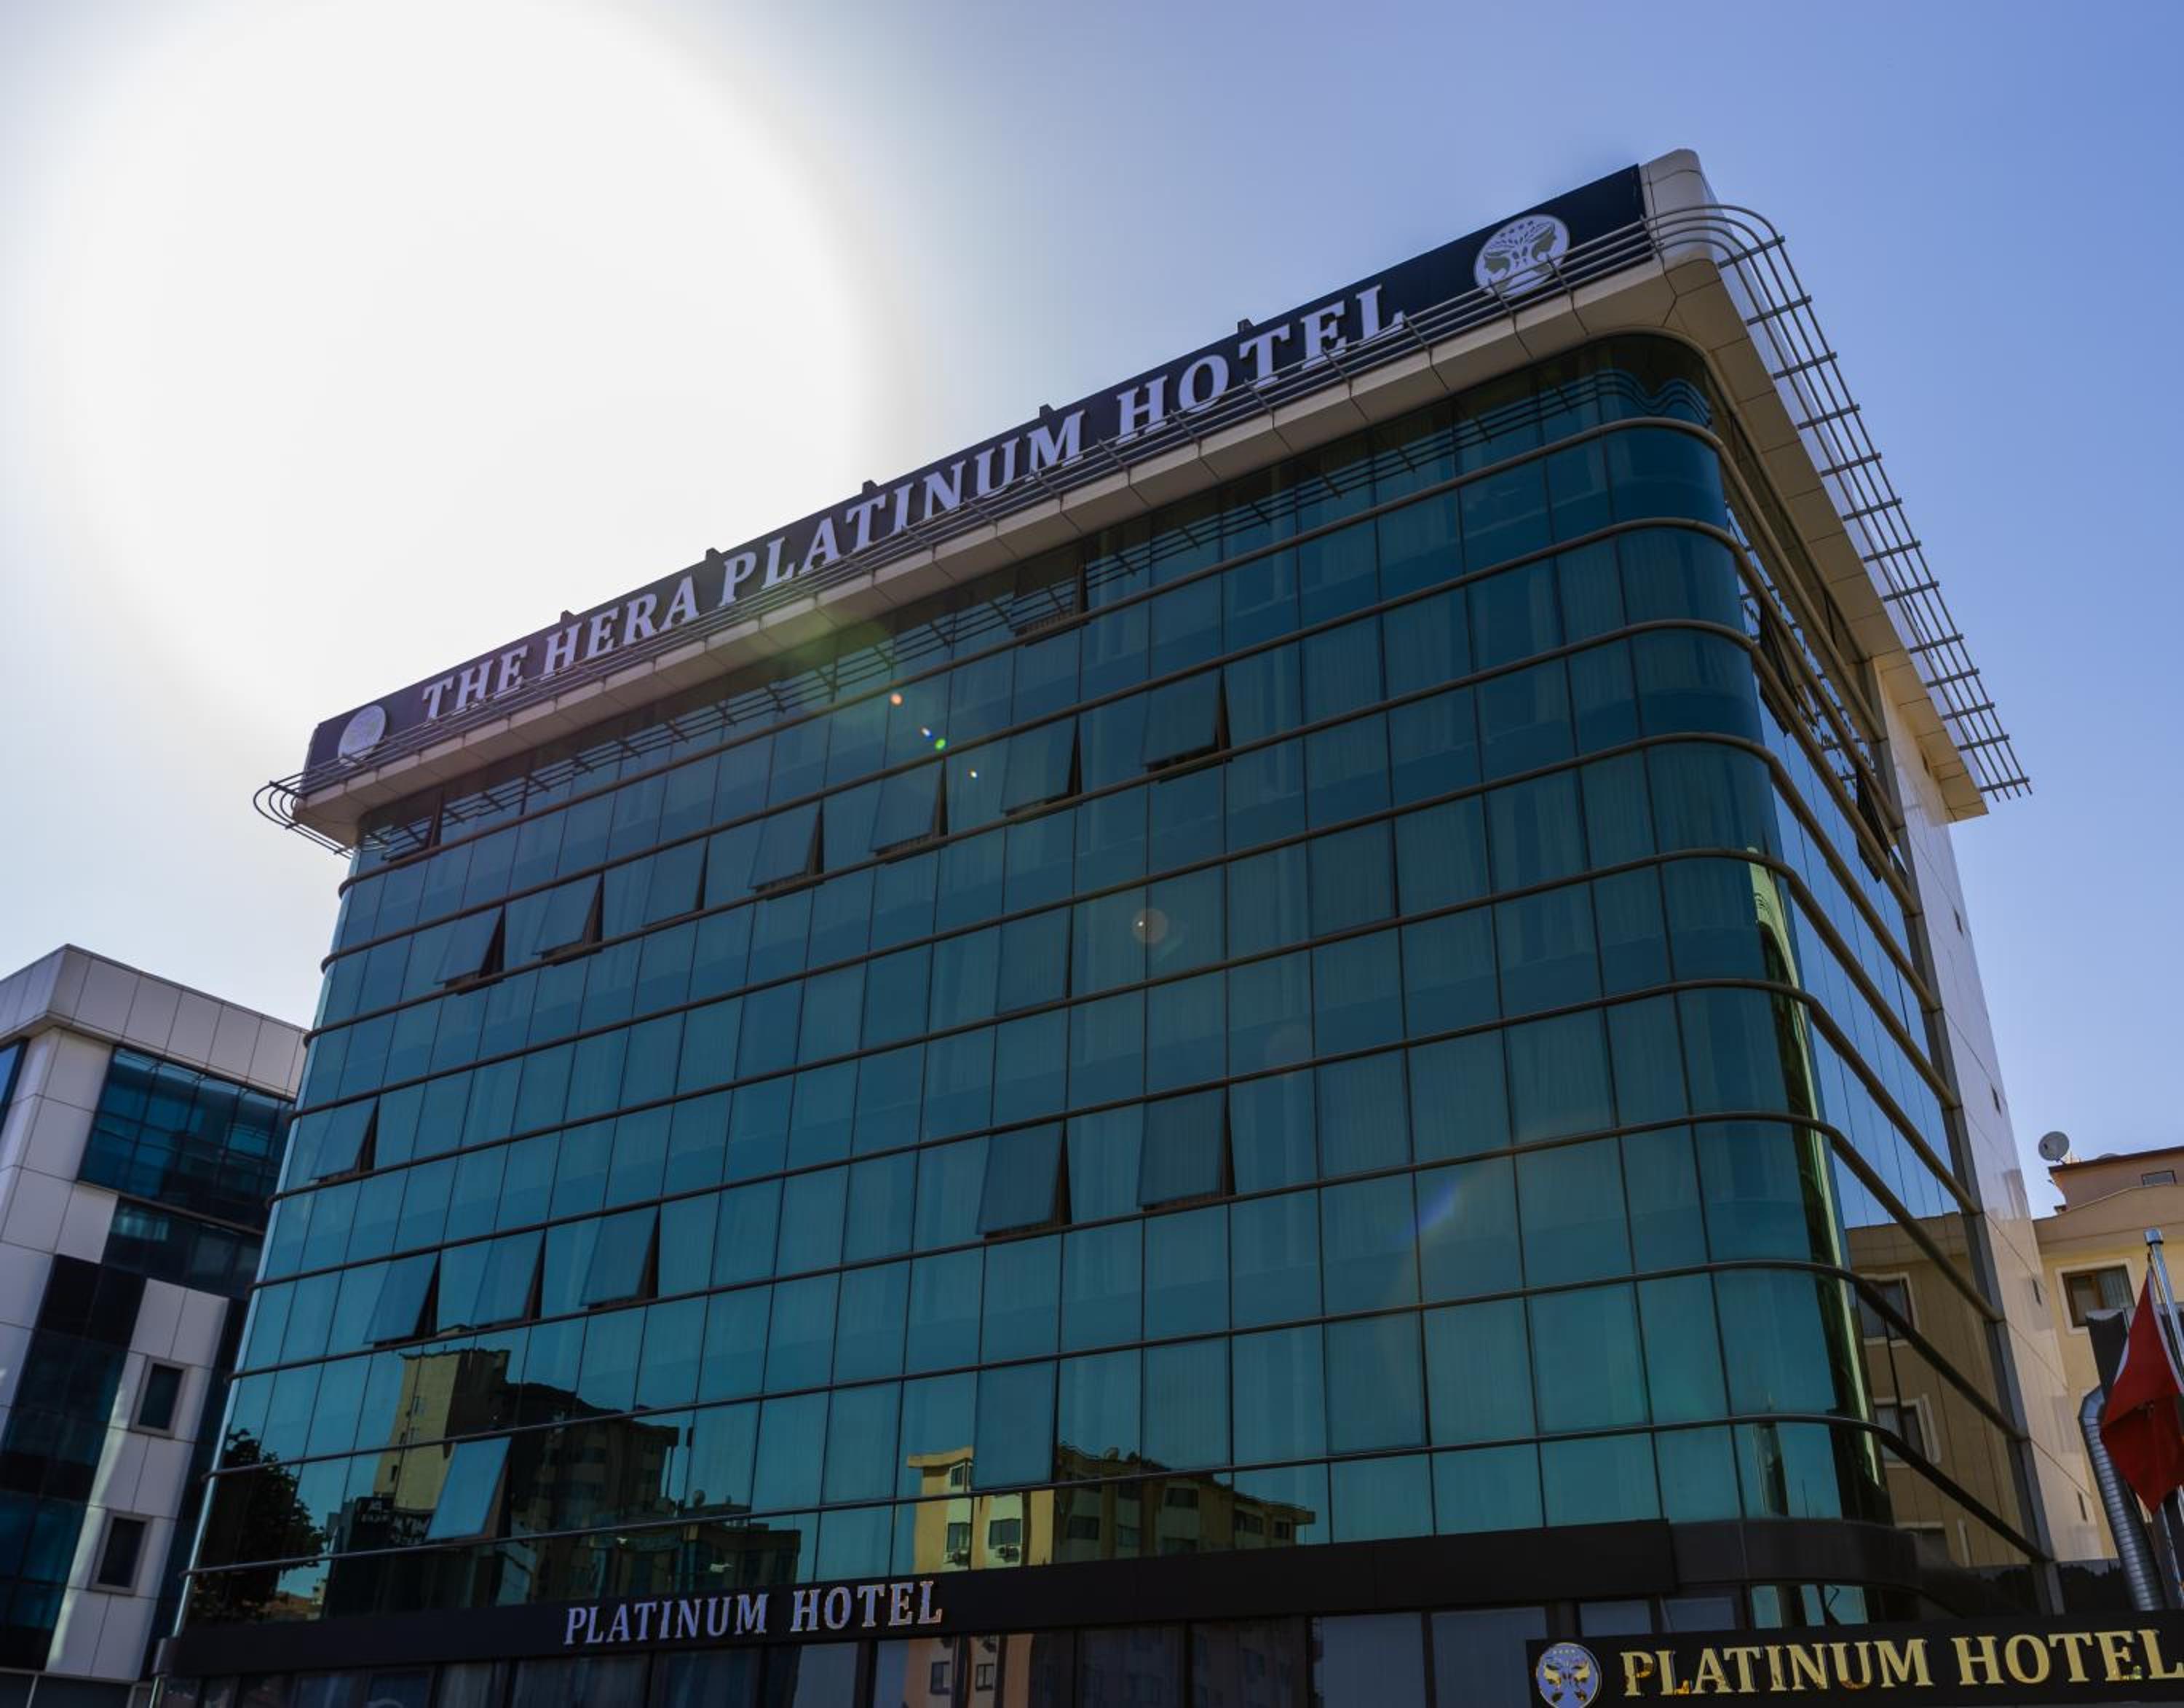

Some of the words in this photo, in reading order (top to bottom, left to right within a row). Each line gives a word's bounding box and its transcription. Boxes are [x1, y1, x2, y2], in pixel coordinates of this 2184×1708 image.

[422, 646, 527, 721] THE
[542, 576, 699, 679] HERA
[719, 410, 1085, 607] PLATINUM
[1116, 285, 1404, 445] HOTEL
[564, 1594, 769, 1645] PLATINUM
[791, 1581, 943, 1632] HOTEL
[1621, 1639, 1933, 1696] PLATINUM
[1952, 1629, 2184, 1685] HOTEL
